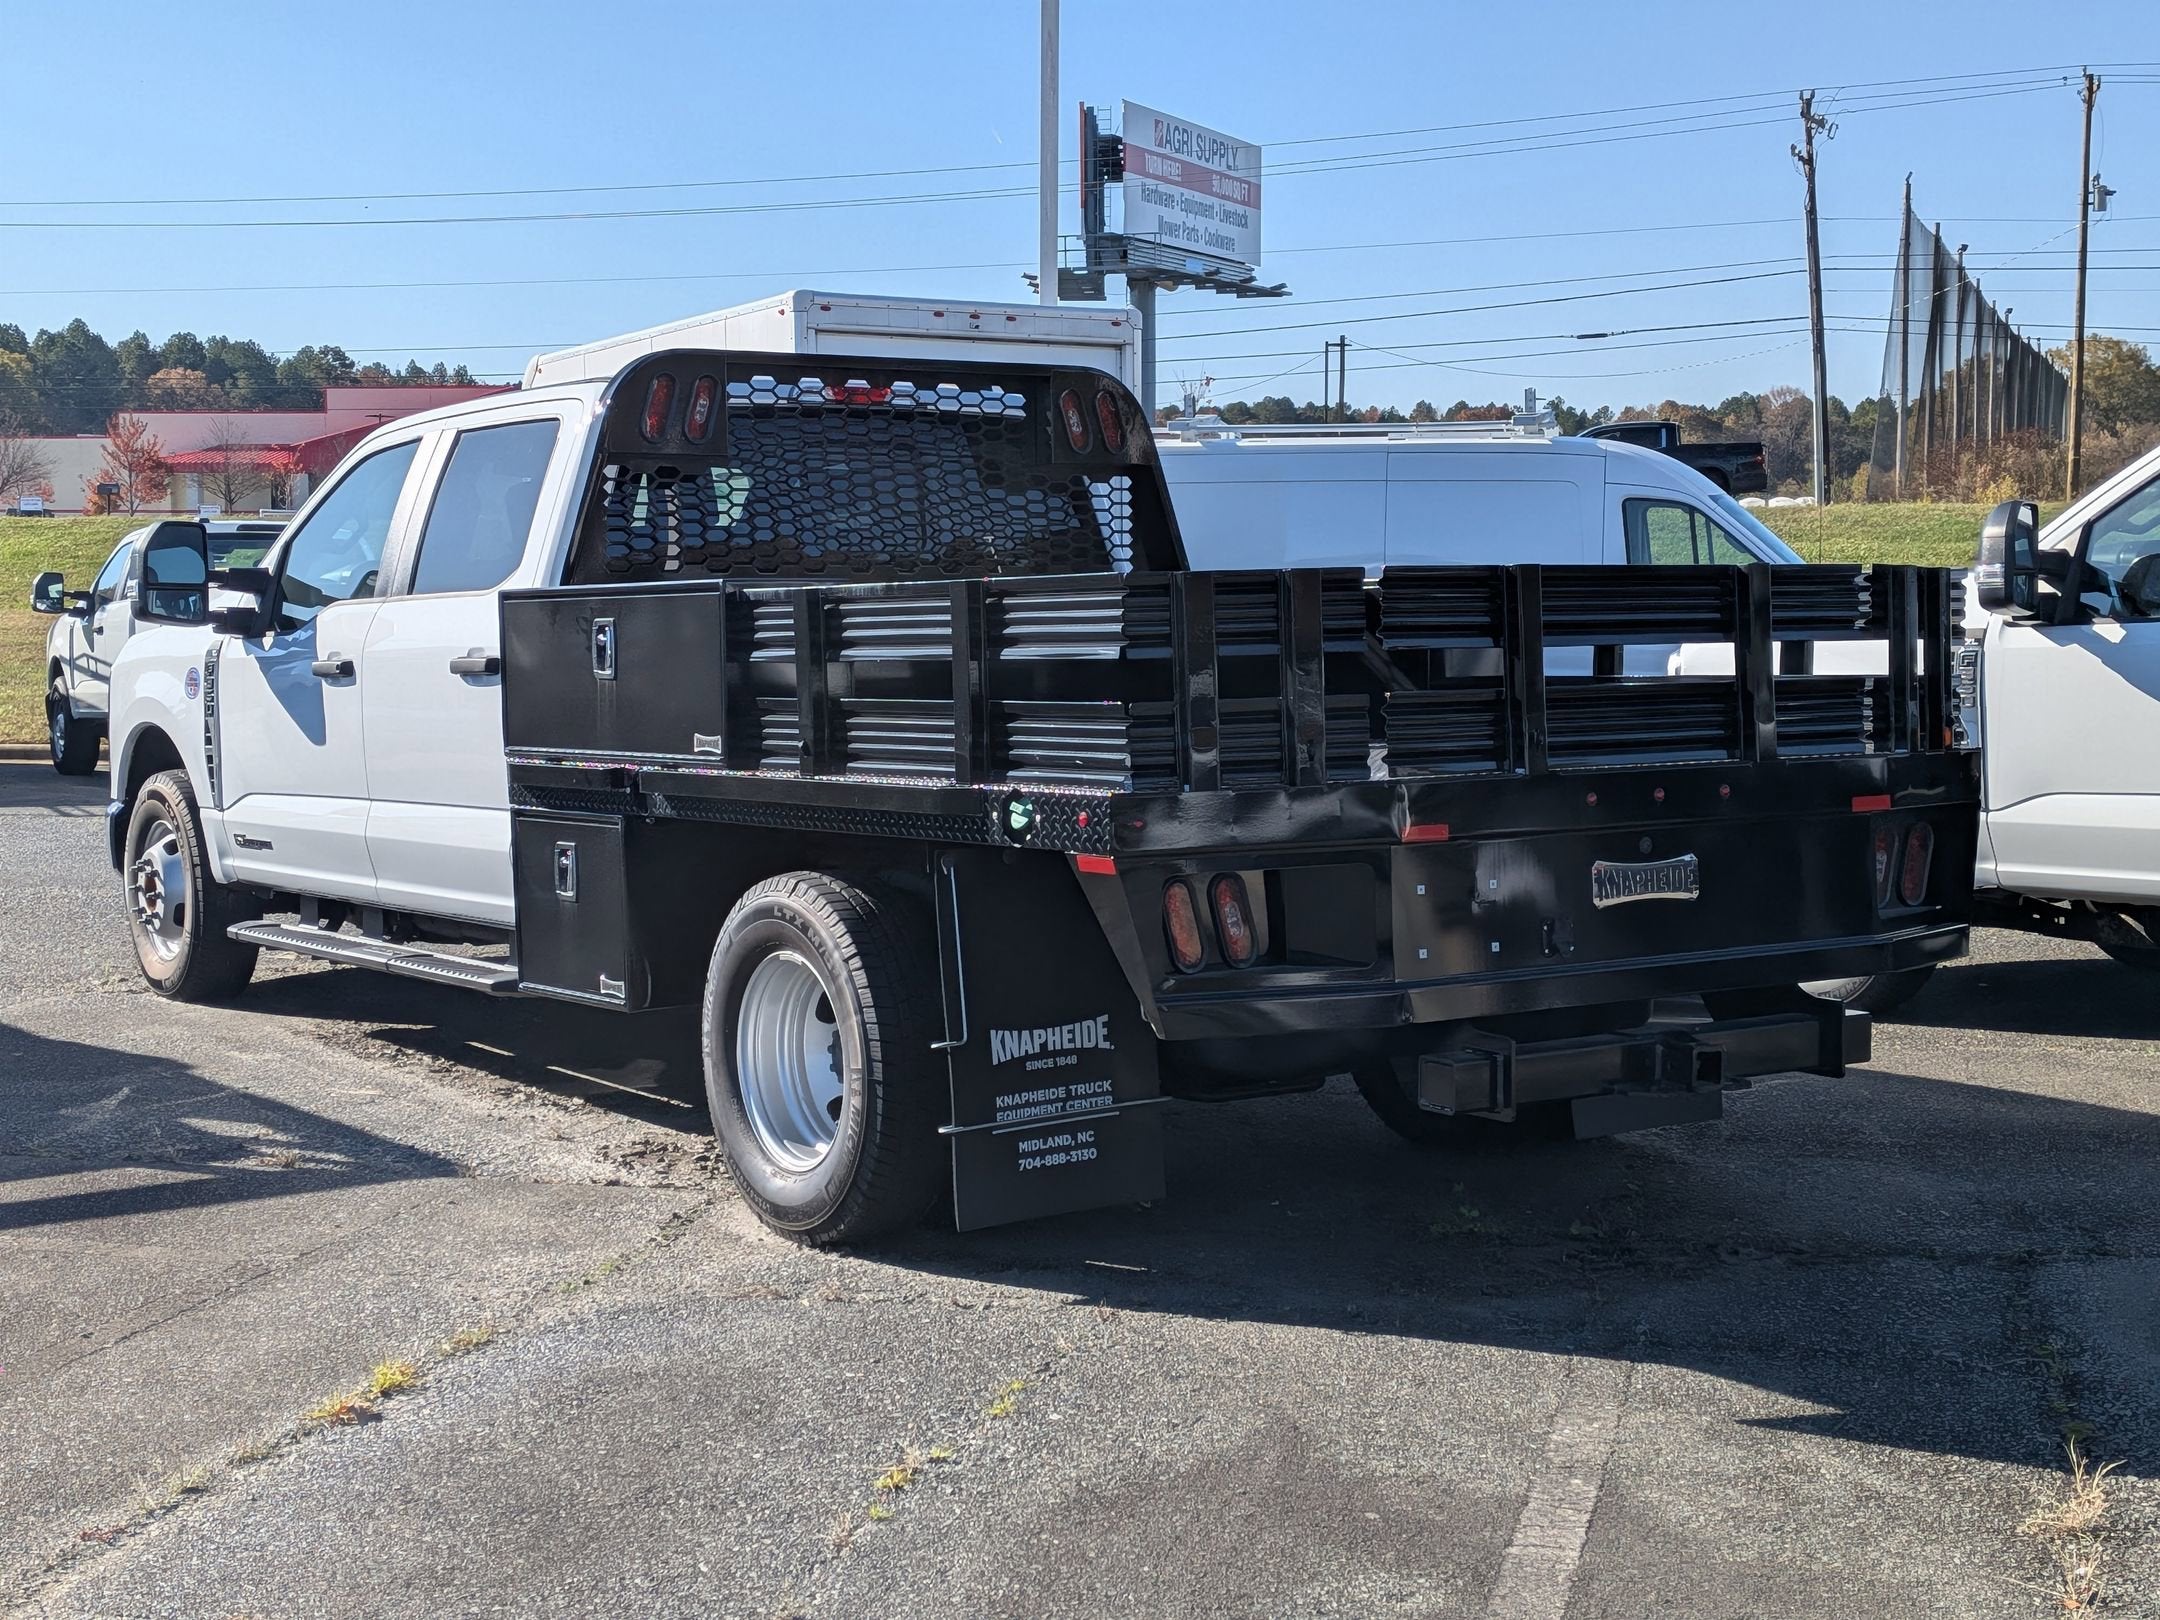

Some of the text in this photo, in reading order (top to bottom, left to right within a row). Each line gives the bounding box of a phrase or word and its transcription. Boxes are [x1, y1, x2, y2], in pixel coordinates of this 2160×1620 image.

[1164, 122, 1193, 158] AGRI
[1140, 180, 1249, 230] Hardware Equipment Livestock
[1181, 220, 1199, 244] Parts
[1203, 226, 1236, 253] Cookware
[1599, 861, 1698, 900] KNAPHEIDE
[1025, 1054, 1078, 1071] SINCE 1848
[995, 1079, 1112, 1108] KNAPHEIDE TRUCK
[996, 1095, 1113, 1122] EQUIPMENT CENTER
[1018, 1130, 1095, 1153] MIDLAND, NC
[1018, 1147, 1098, 1171] 704-888-3130
